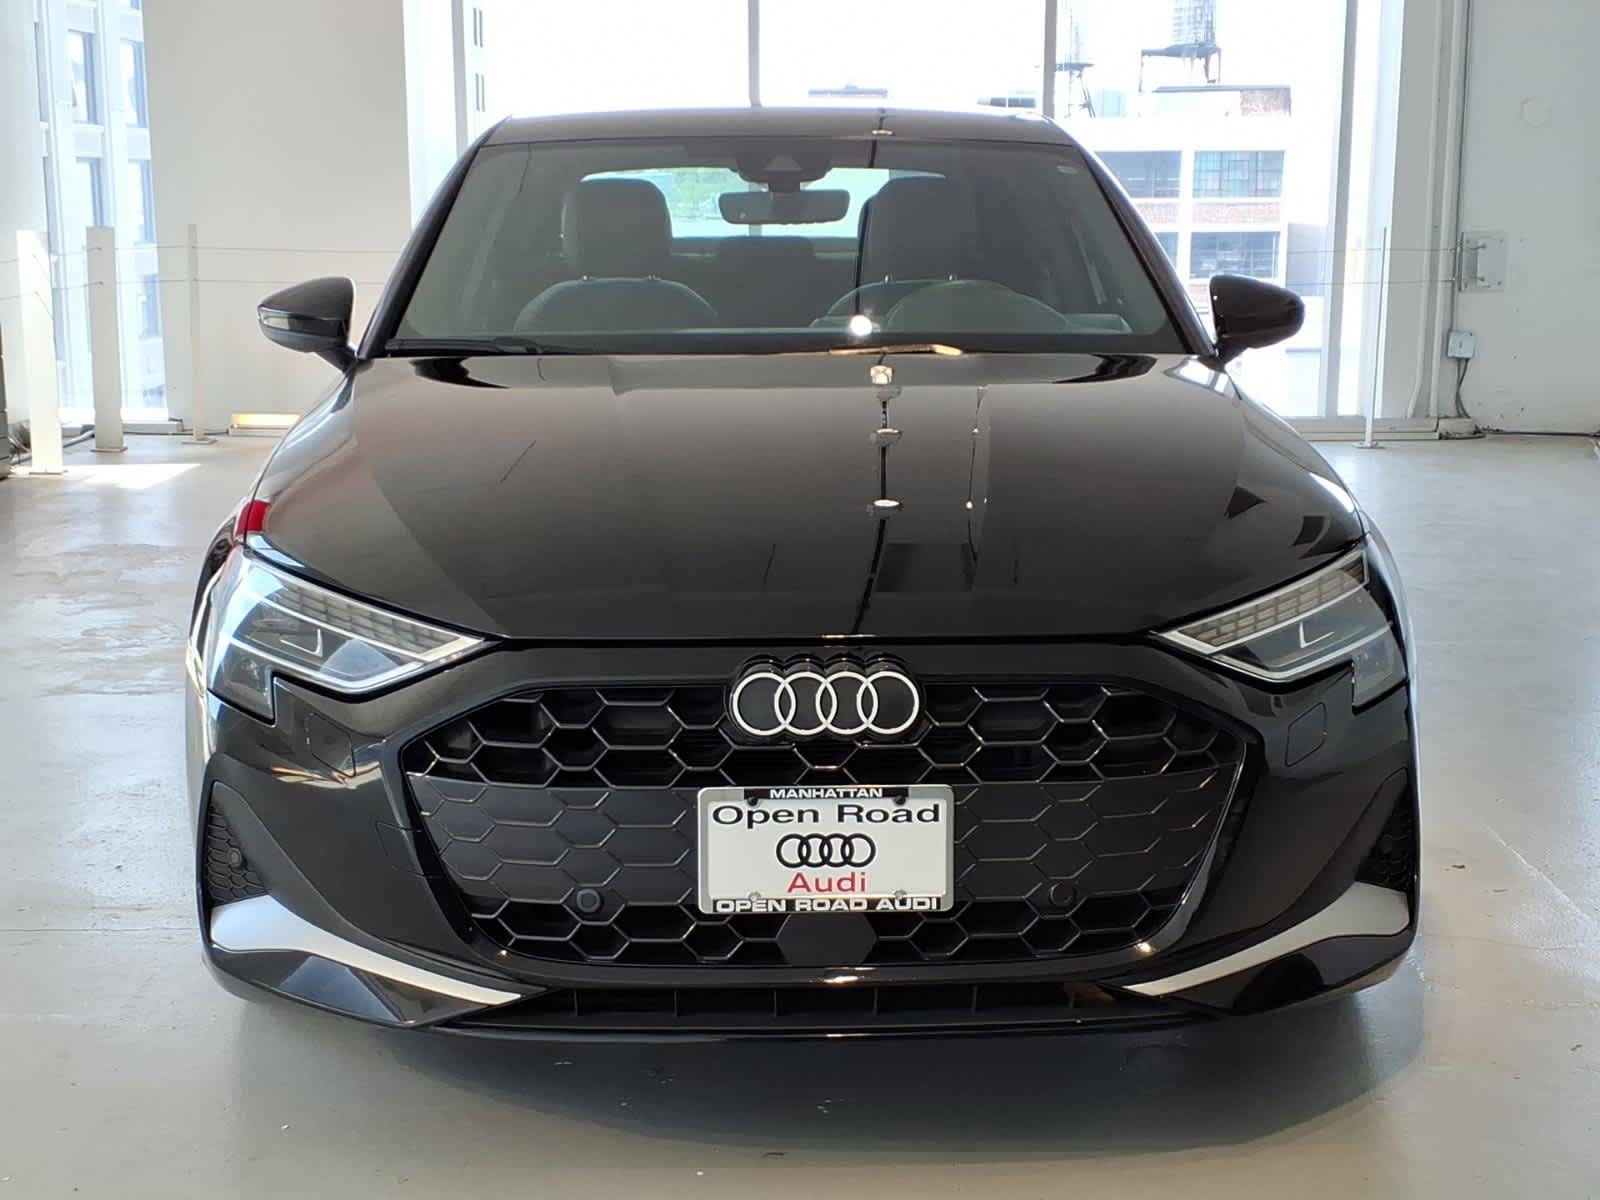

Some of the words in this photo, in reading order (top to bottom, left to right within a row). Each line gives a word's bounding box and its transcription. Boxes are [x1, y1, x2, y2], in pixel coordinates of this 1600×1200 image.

[769, 788, 883, 799] MANHATTAN
[712, 805, 819, 829] Open
[837, 804, 940, 824] Road
[787, 872, 867, 893] Audi
[716, 899, 786, 912] OPEN
[795, 898, 868, 912] ROAD
[876, 897, 937, 911] AUDI
